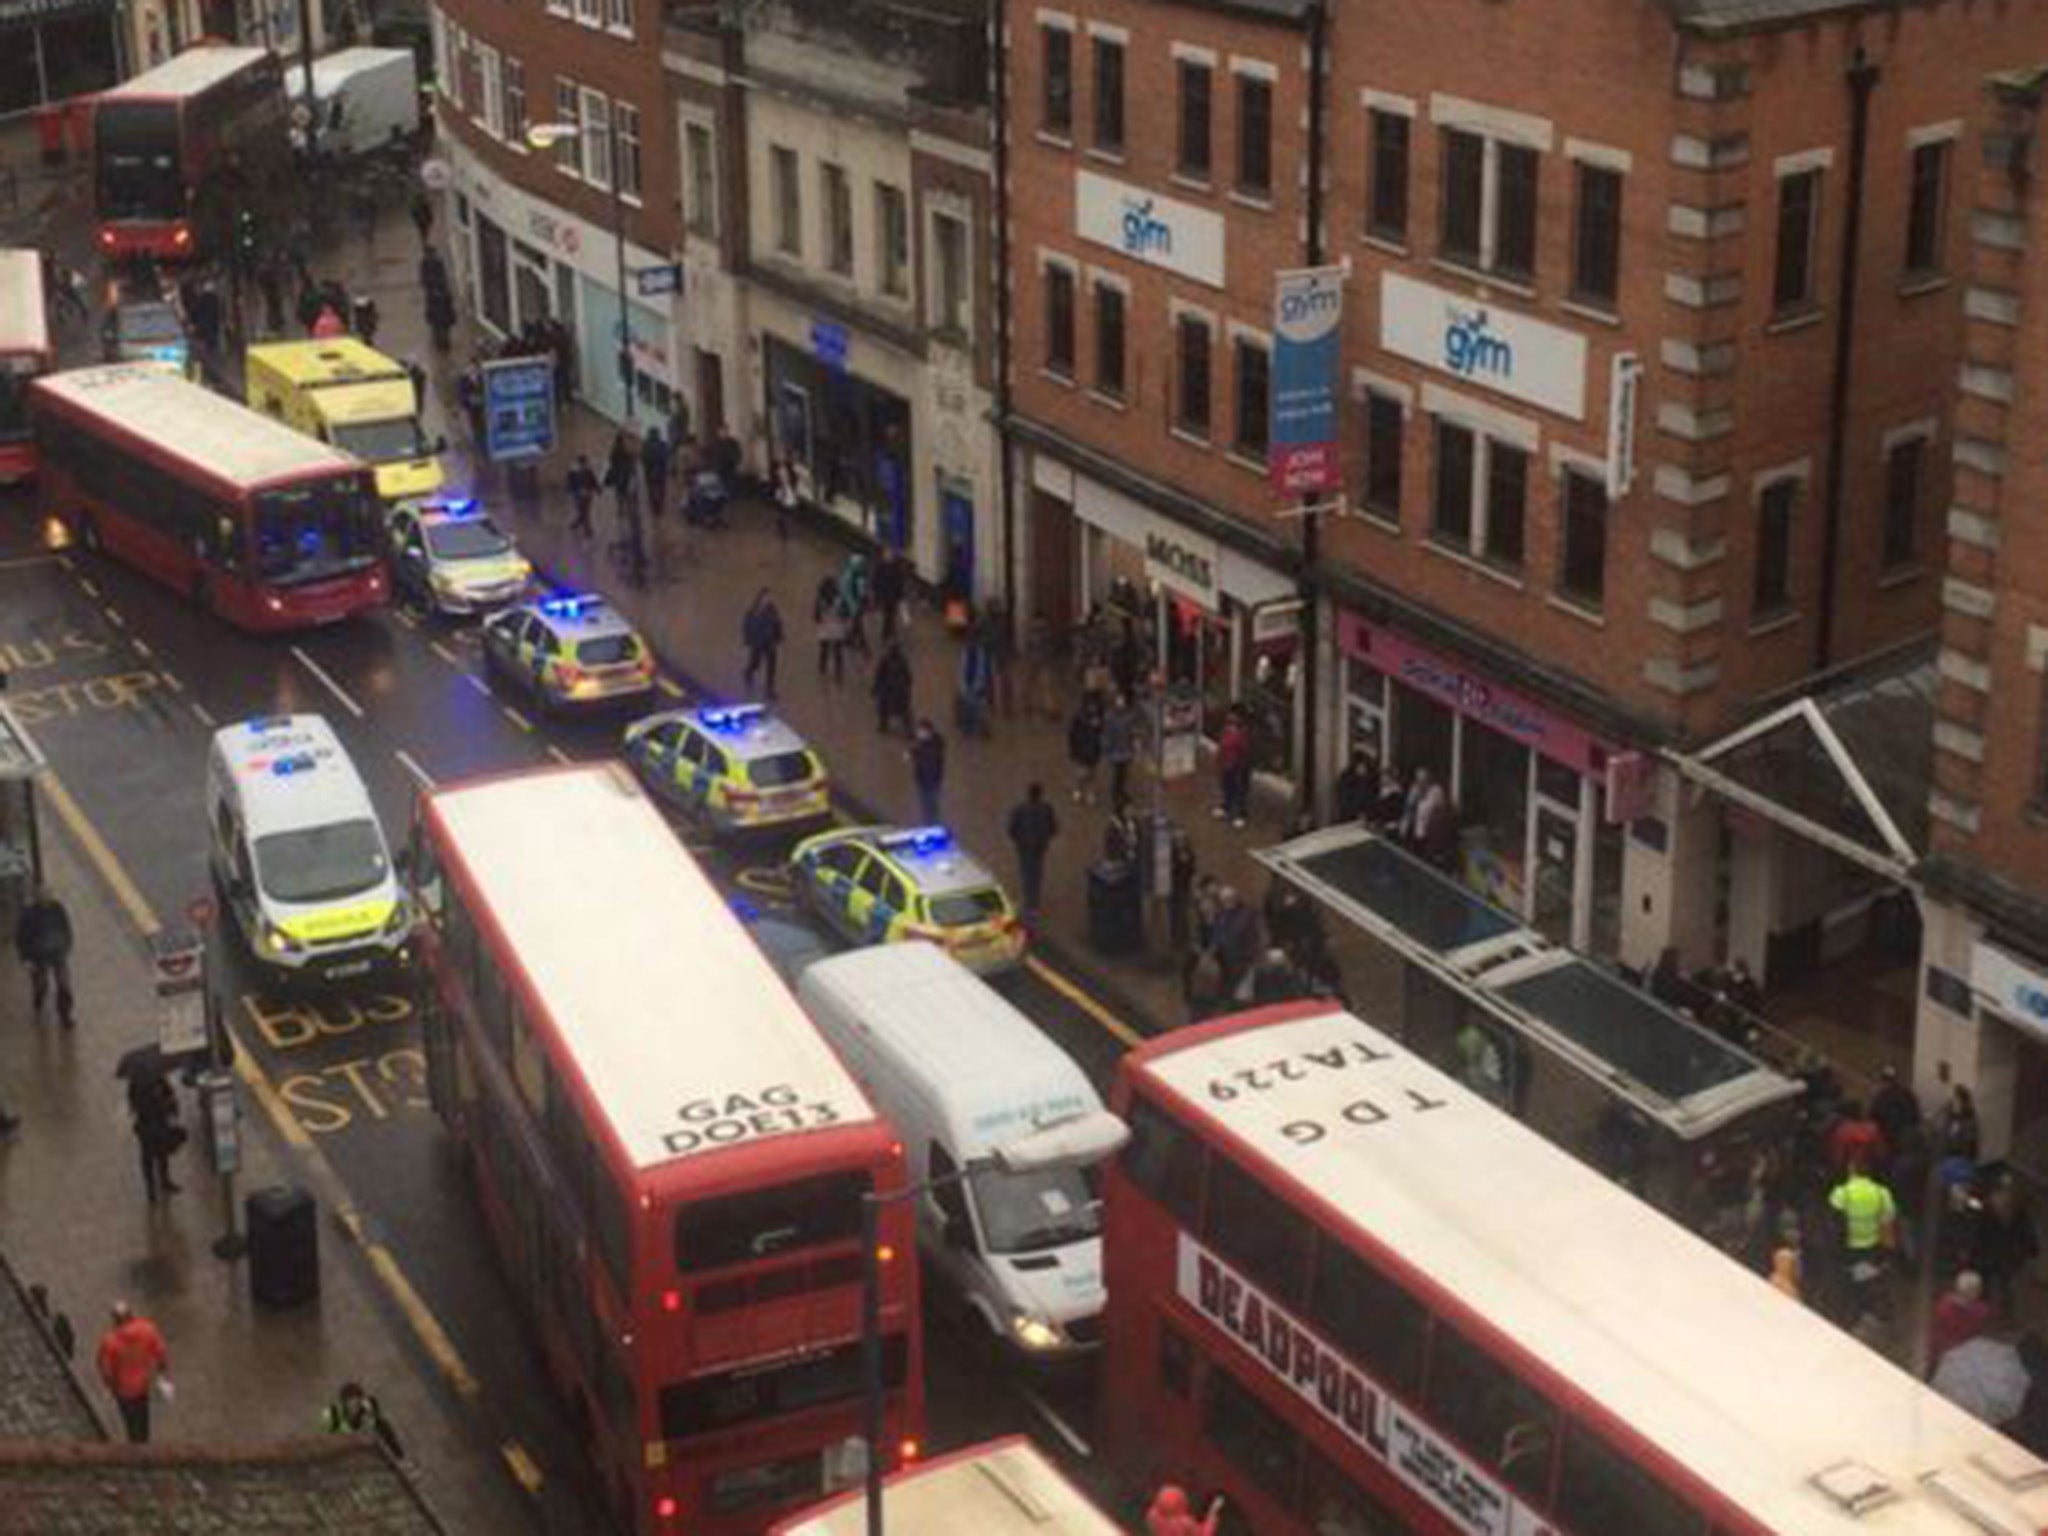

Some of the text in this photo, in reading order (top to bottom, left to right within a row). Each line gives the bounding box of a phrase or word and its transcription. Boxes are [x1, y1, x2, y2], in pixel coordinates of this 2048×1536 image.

[1121, 211, 1171, 254] gym
[1282, 288, 1339, 323] gym
[1445, 323, 1513, 378] gym
[1147, 531, 1213, 589] MOSS
[3, 671, 157, 725] STOP
[1208, 1041, 1393, 1101] TA229
[662, 1102, 840, 1154] DOE13
[677, 1083, 800, 1123] GAG
[1198, 1250, 1391, 1461] DEADPOOL
